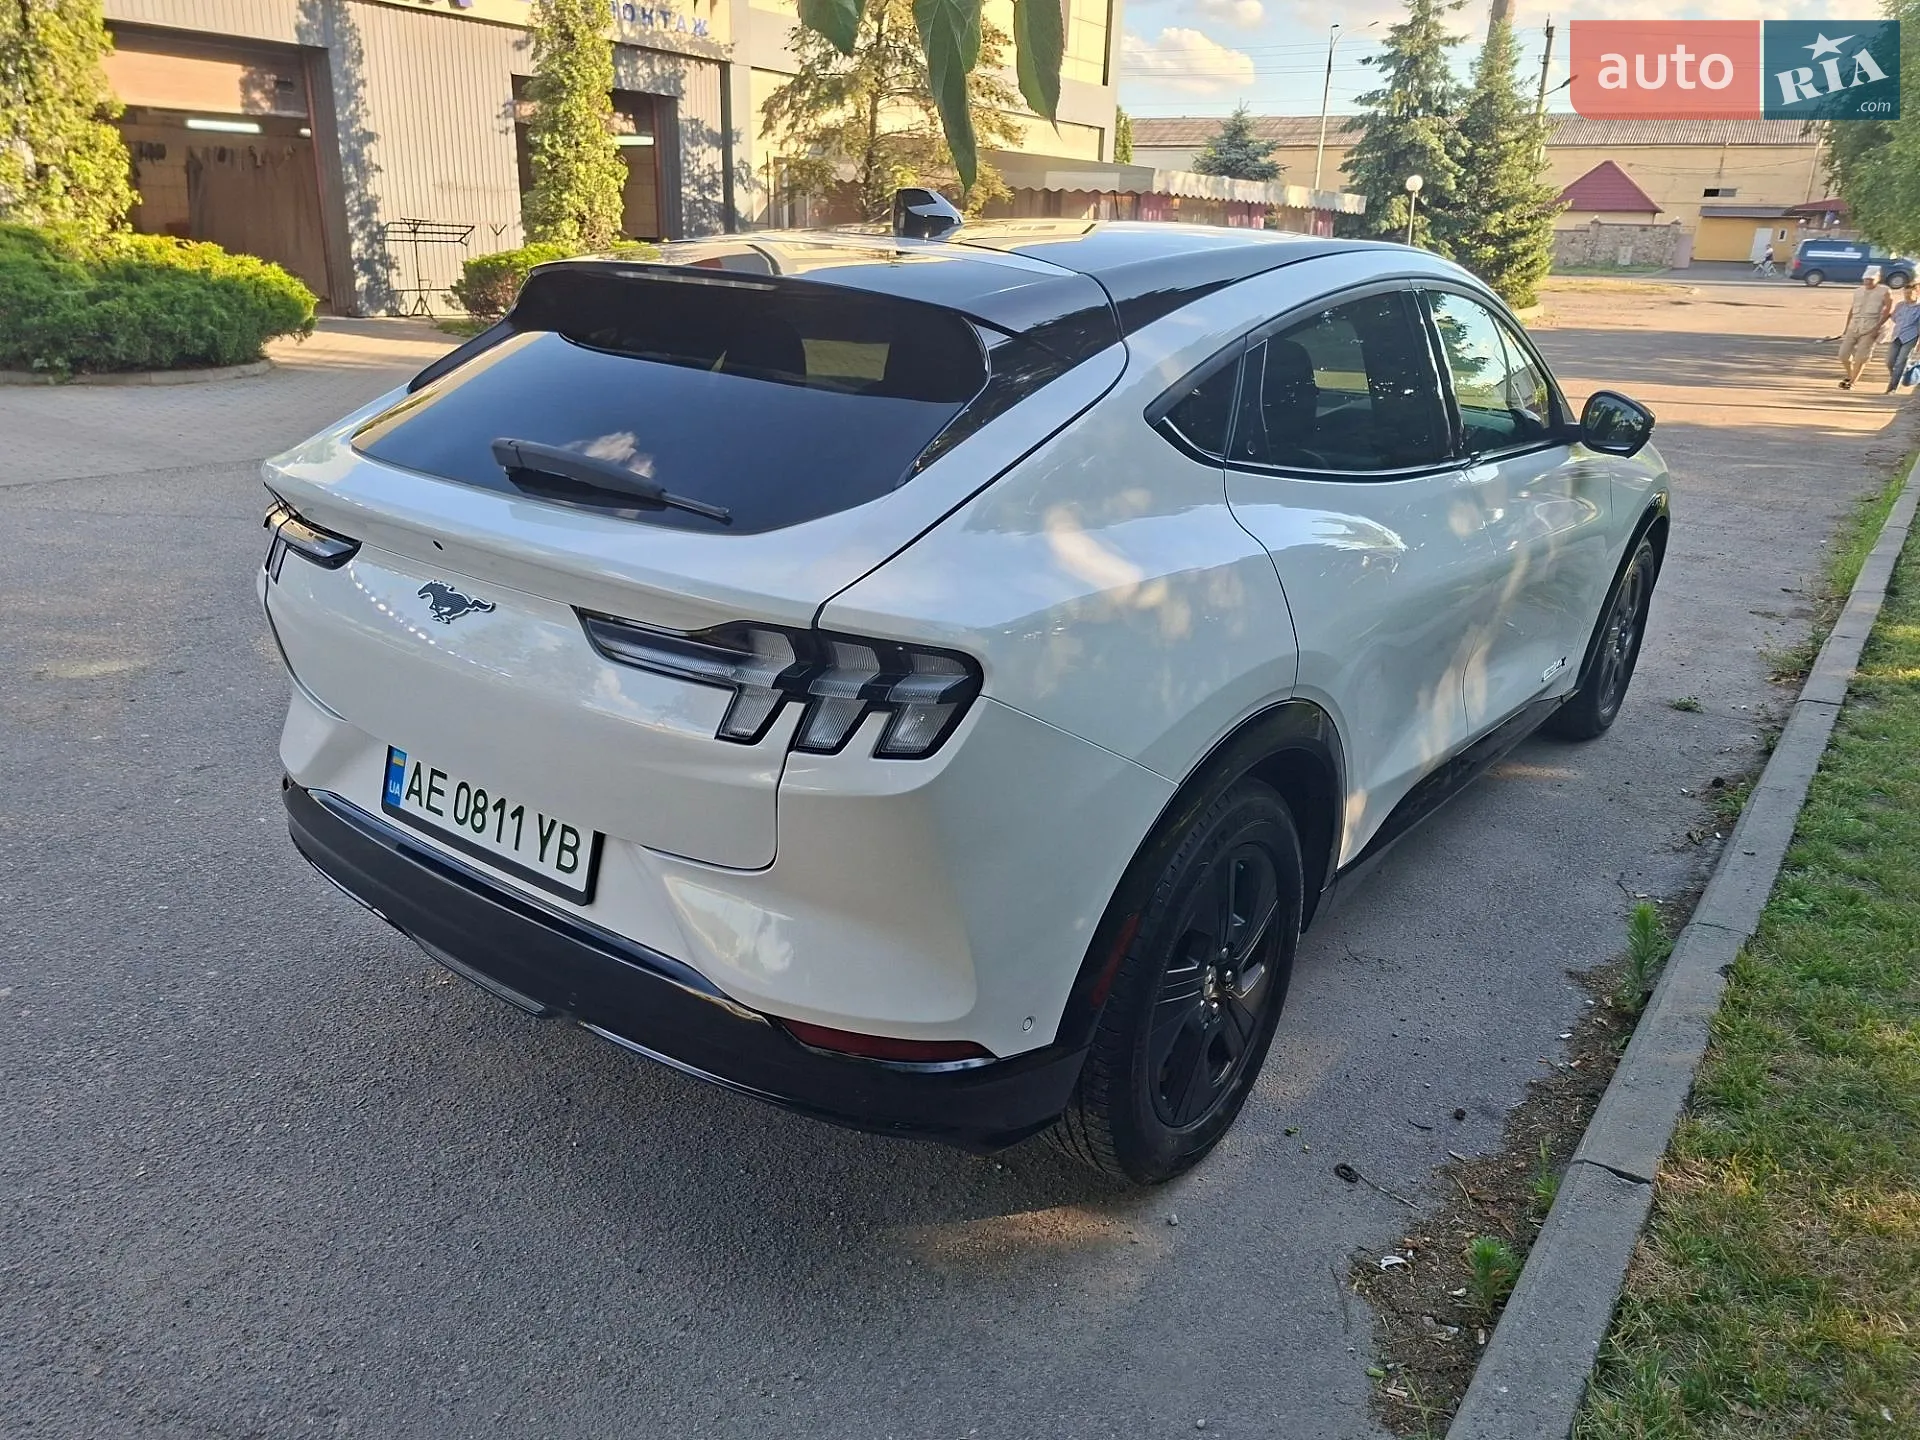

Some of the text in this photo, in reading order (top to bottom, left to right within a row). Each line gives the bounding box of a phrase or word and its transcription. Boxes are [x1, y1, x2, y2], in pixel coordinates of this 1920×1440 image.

[389, 779, 401, 797] UA
[405, 761, 581, 874] AE 0811 YB
